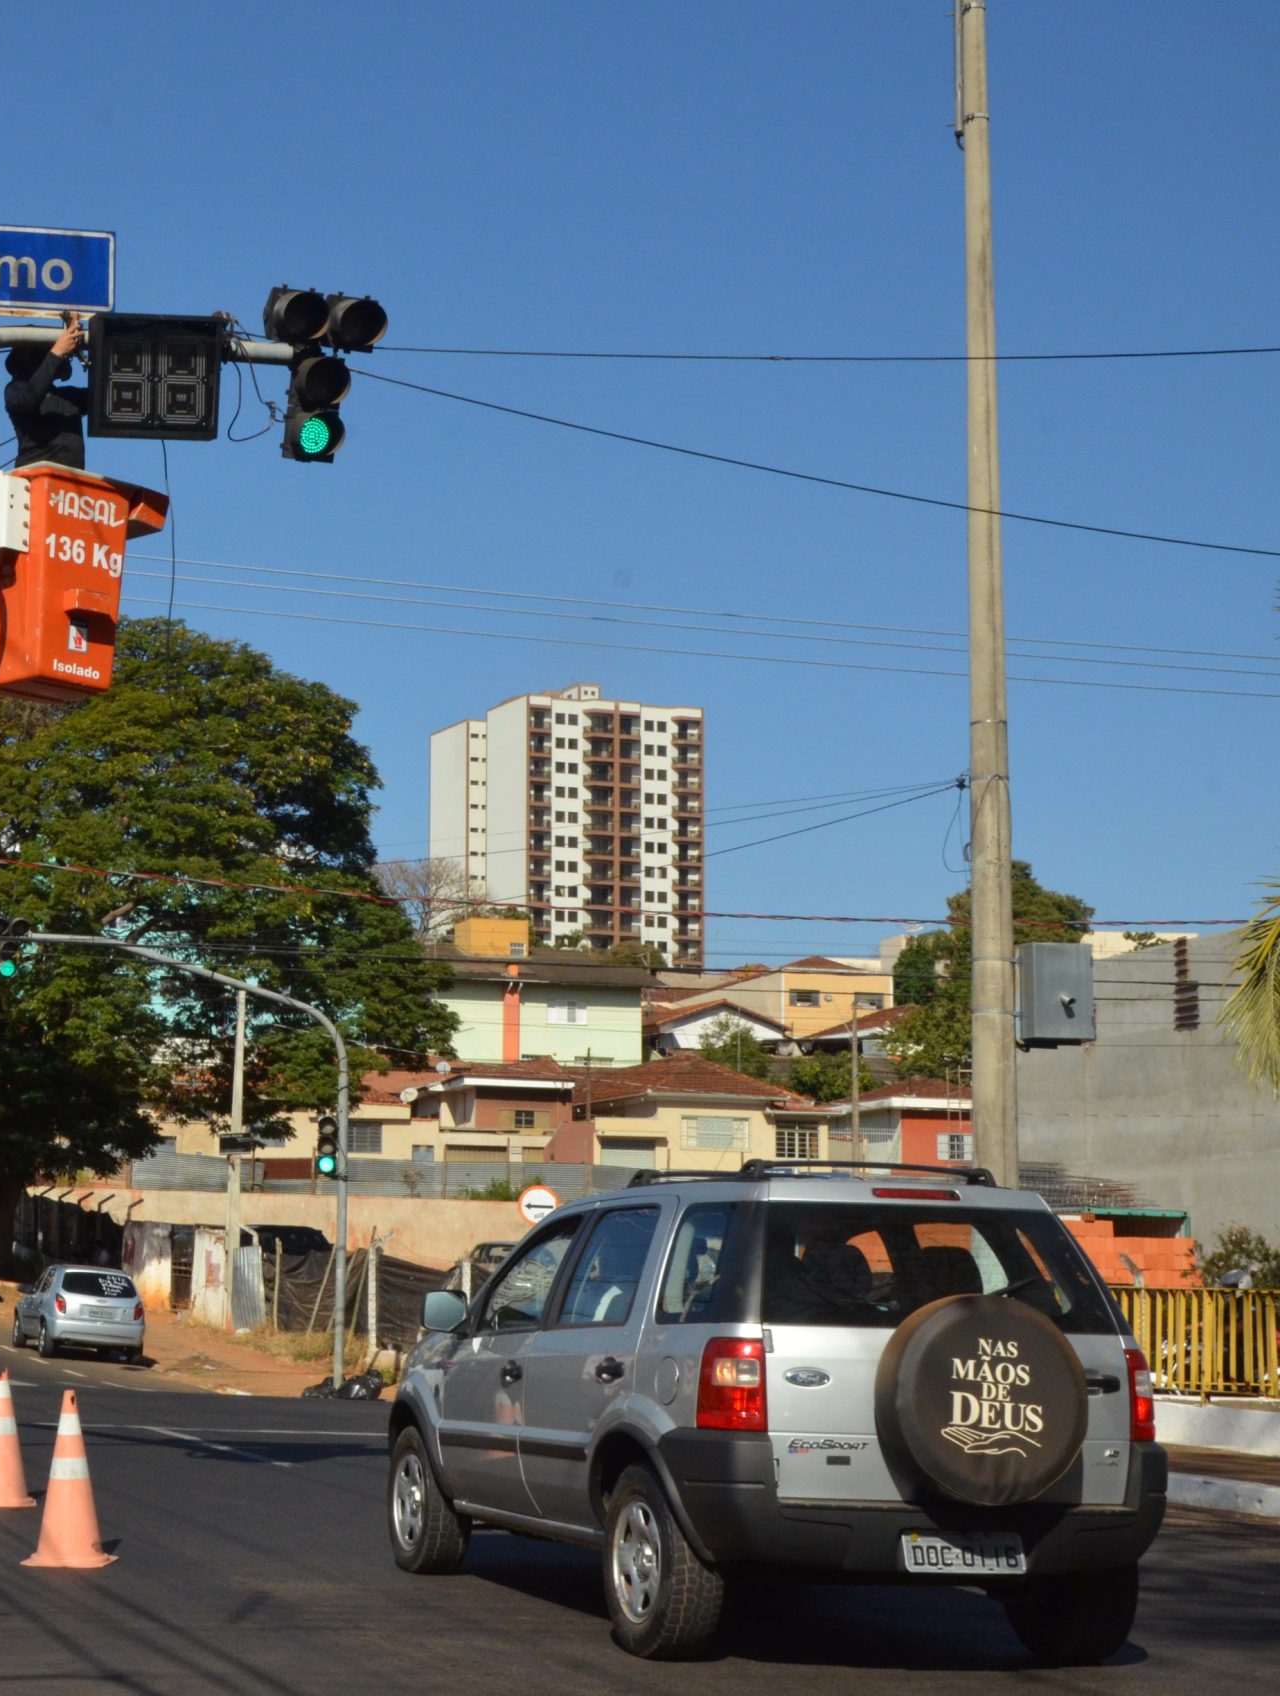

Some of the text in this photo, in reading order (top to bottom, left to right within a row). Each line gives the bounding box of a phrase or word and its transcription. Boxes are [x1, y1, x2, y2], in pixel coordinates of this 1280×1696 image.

[49, 489, 125, 527] MASAL
[45, 533, 123, 577] 136 Kg
[52, 659, 100, 680] Isolado
[977, 1338, 1019, 1358] NAS
[951, 1355, 1030, 1386] MÃOS
[980, 1382, 1011, 1402] DE
[948, 1390, 1044, 1433] DEUS
